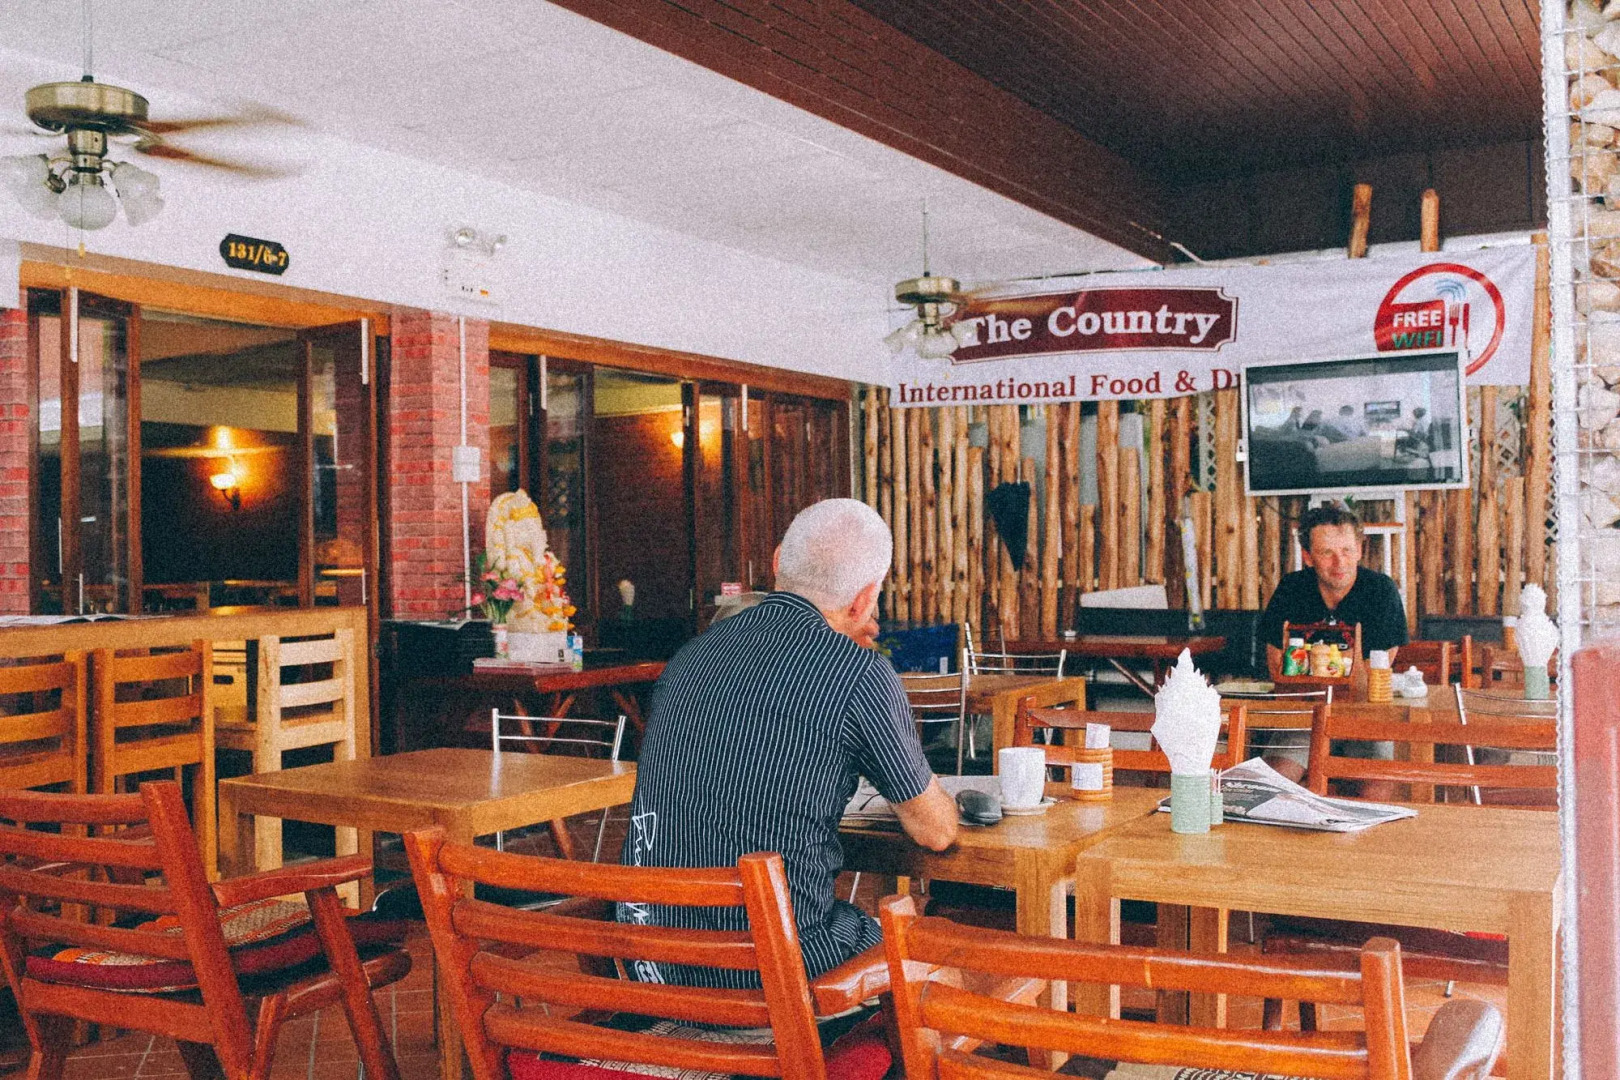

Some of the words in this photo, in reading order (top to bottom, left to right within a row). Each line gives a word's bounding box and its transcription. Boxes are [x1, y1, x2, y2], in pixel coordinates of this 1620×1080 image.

[228, 242, 287, 266] 131/6-7
[958, 314, 1032, 348] The
[1047, 304, 1220, 343] Country
[1393, 310, 1441, 328] FREE
[898, 375, 1077, 403] International
[1090, 370, 1162, 395] Food
[1174, 370, 1197, 392] &
